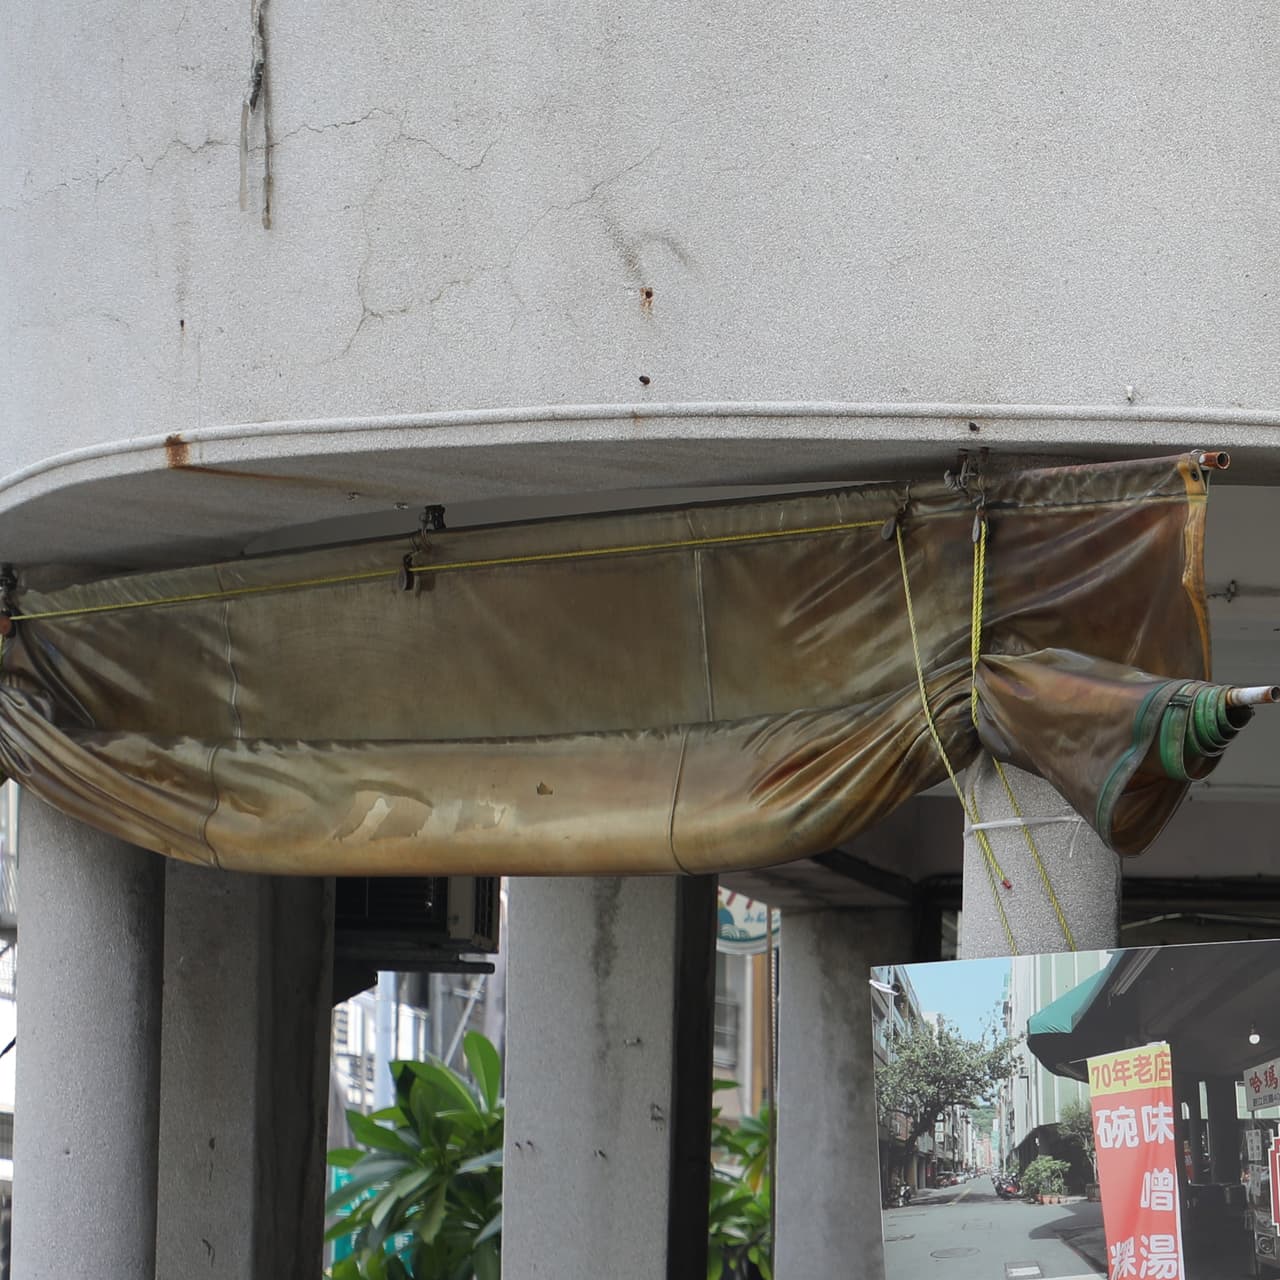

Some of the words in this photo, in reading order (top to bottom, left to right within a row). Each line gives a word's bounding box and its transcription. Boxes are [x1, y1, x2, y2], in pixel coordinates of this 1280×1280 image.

[1090, 1050, 1172, 1090] 70年老店
[1138, 1103, 1178, 1279] 味噌湯
